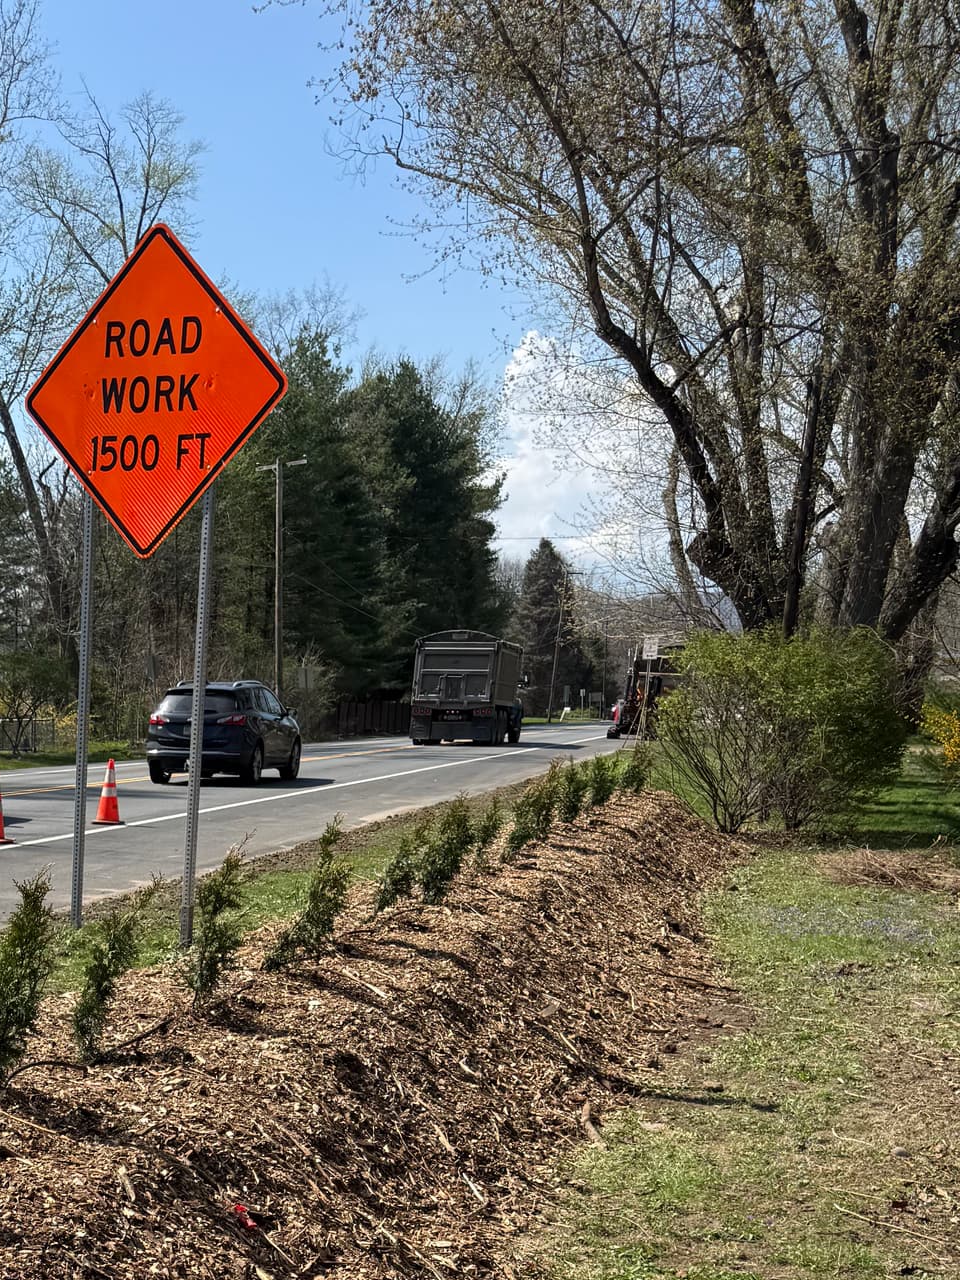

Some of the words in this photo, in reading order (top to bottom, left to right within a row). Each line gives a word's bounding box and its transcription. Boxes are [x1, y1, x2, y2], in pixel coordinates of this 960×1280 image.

[104, 316, 202, 358] ROAD
[101, 373, 200, 414] WORK
[90, 434, 160, 472] 1500
[176, 432, 211, 469] FT
